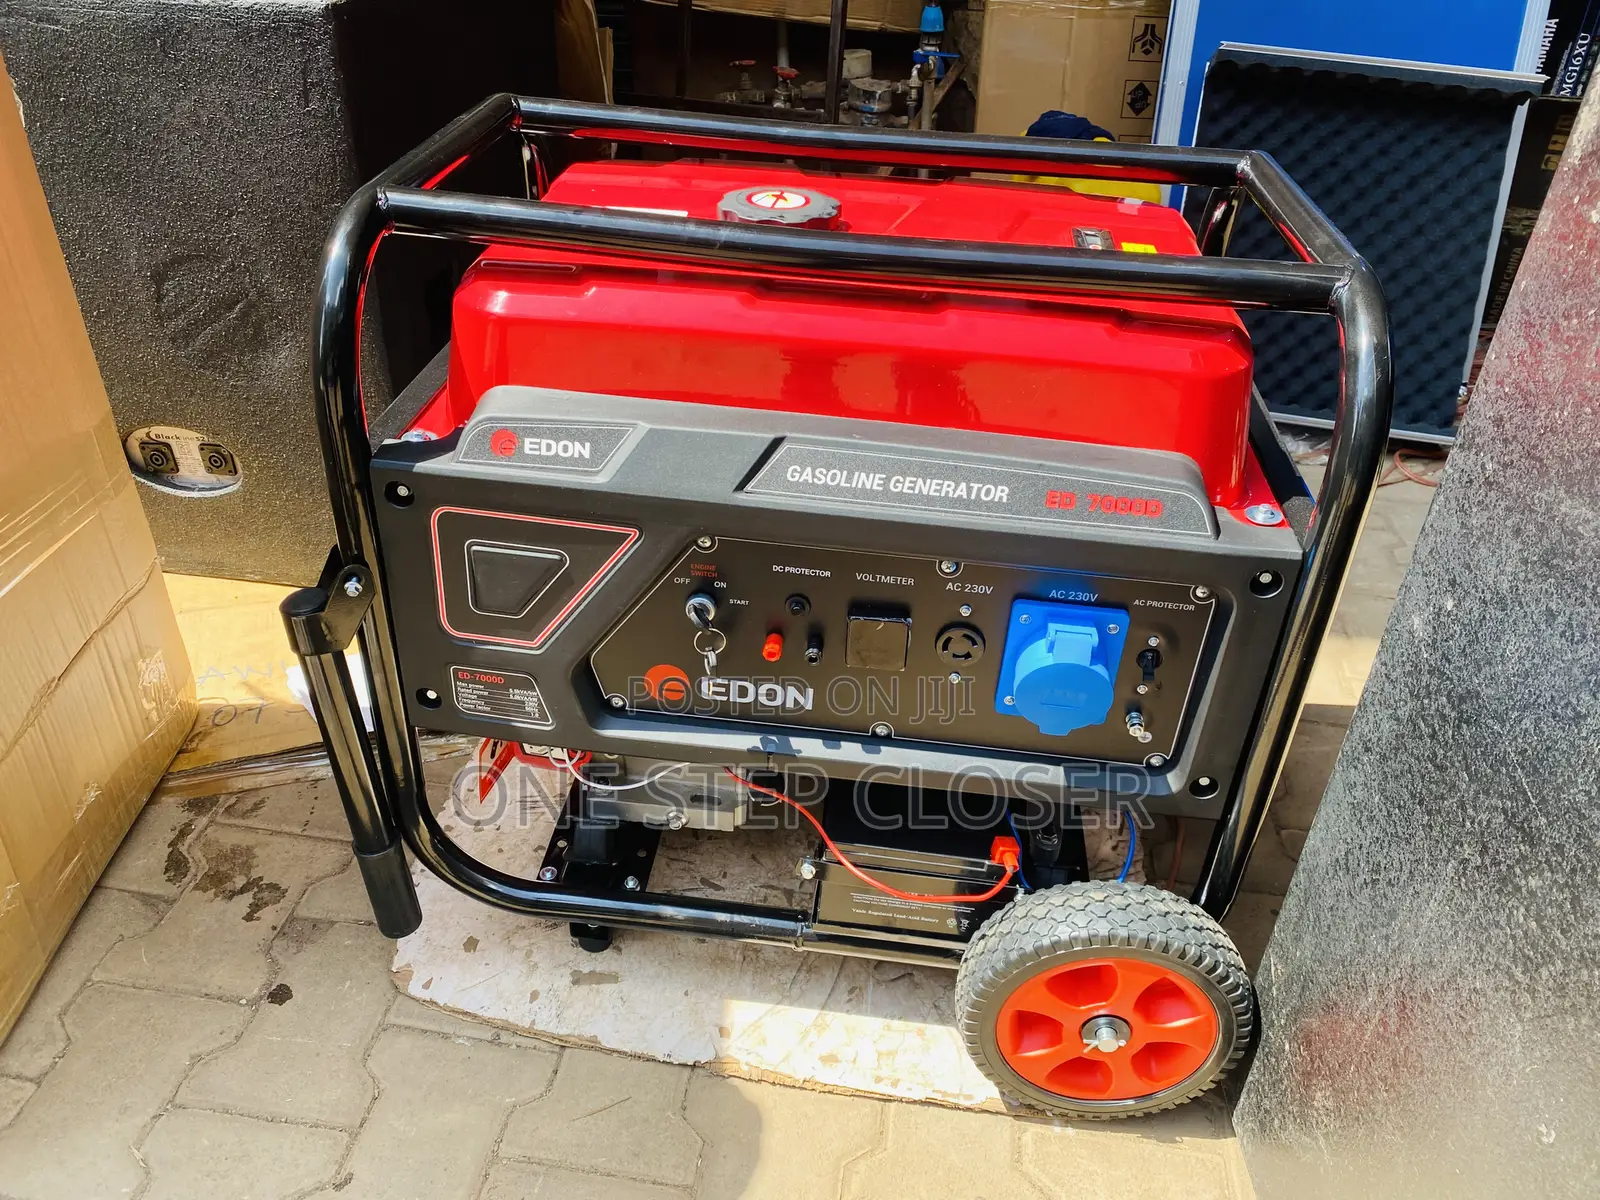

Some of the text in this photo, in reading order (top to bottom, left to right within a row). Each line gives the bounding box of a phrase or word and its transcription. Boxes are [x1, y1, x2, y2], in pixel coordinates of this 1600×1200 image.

[1560, 33, 1591, 96] MG16XU
[1504, 247, 1524, 281] CHINA
[524, 437, 590, 459] EDON
[786, 464, 1009, 503] GASOLINE GENERATOR
[1046, 490, 1163, 518] ED 7000D
[691, 563, 717, 572] ENGINE
[785, 566, 831, 578] PROTECTOR
[690, 570, 718, 578] SWITCH
[855, 572, 915, 586] VOLTMETER
[674, 577, 691, 585] OFF
[714, 581, 727, 589] ON
[945, 582, 994, 595] AC 230V
[1049, 589, 1099, 602] AC 230V
[1146, 600, 1196, 612] PROTECTOR
[457, 672, 505, 684] ED-7000D
[458, 692, 478, 700] Voltage
[701, 676, 814, 710] EDON
[458, 697, 485, 706] Frequency
[893, 912, 920, 921] Lead-Acid
[920, 916, 939, 924] Battery
